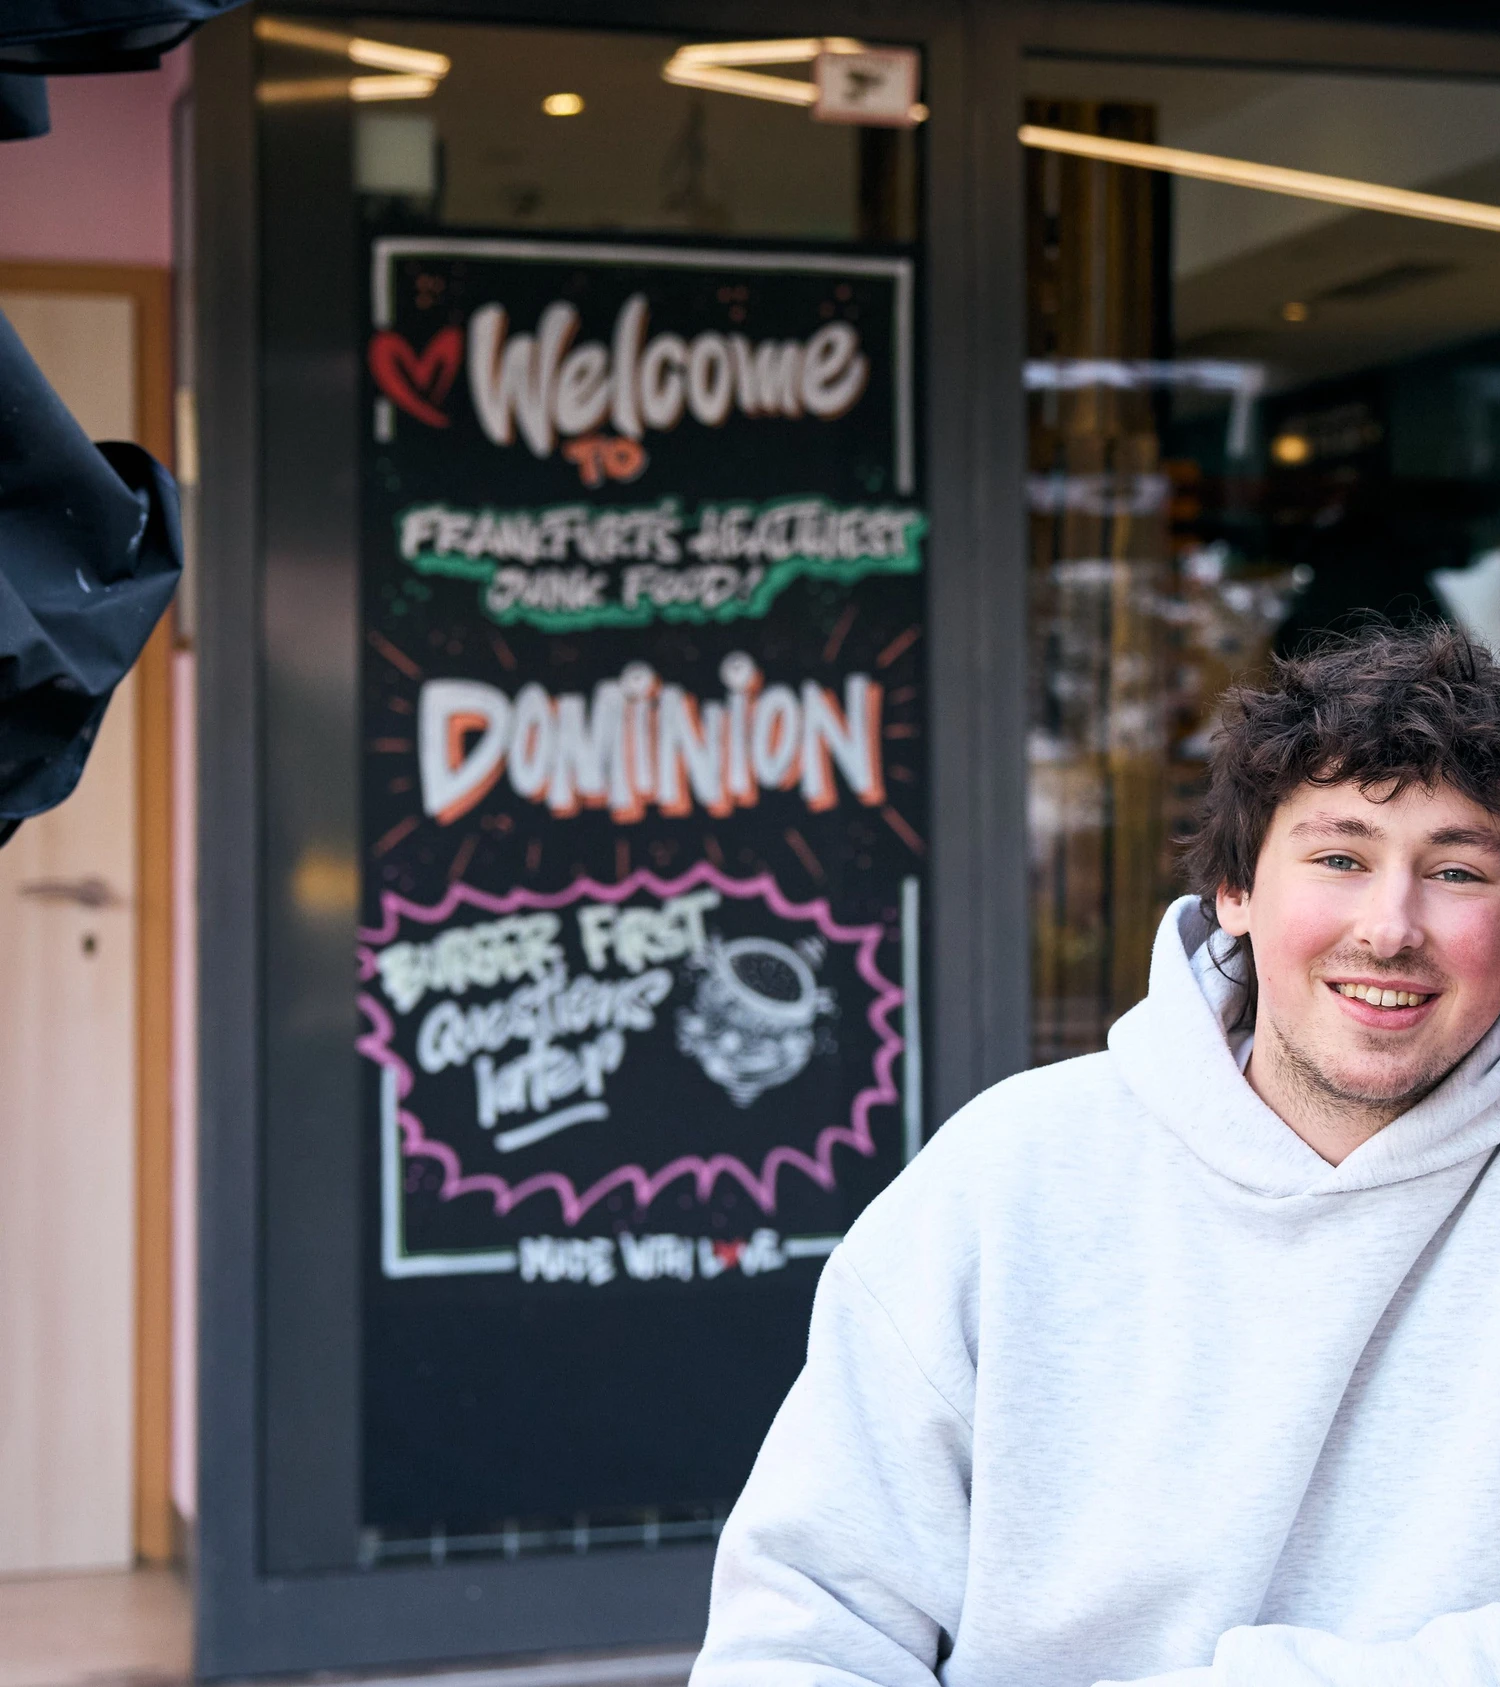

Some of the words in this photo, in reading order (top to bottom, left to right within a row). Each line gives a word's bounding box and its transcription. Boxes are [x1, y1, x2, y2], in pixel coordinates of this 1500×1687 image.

[468, 294, 868, 456] Welcome
[562, 436, 648, 486] TO
[488, 566, 606, 611] JUNK
[381, 913, 563, 1012] BURGER
[579, 890, 720, 970] FIRST
[518, 1234, 616, 1287] MADE
[617, 1230, 695, 1283] WITH
